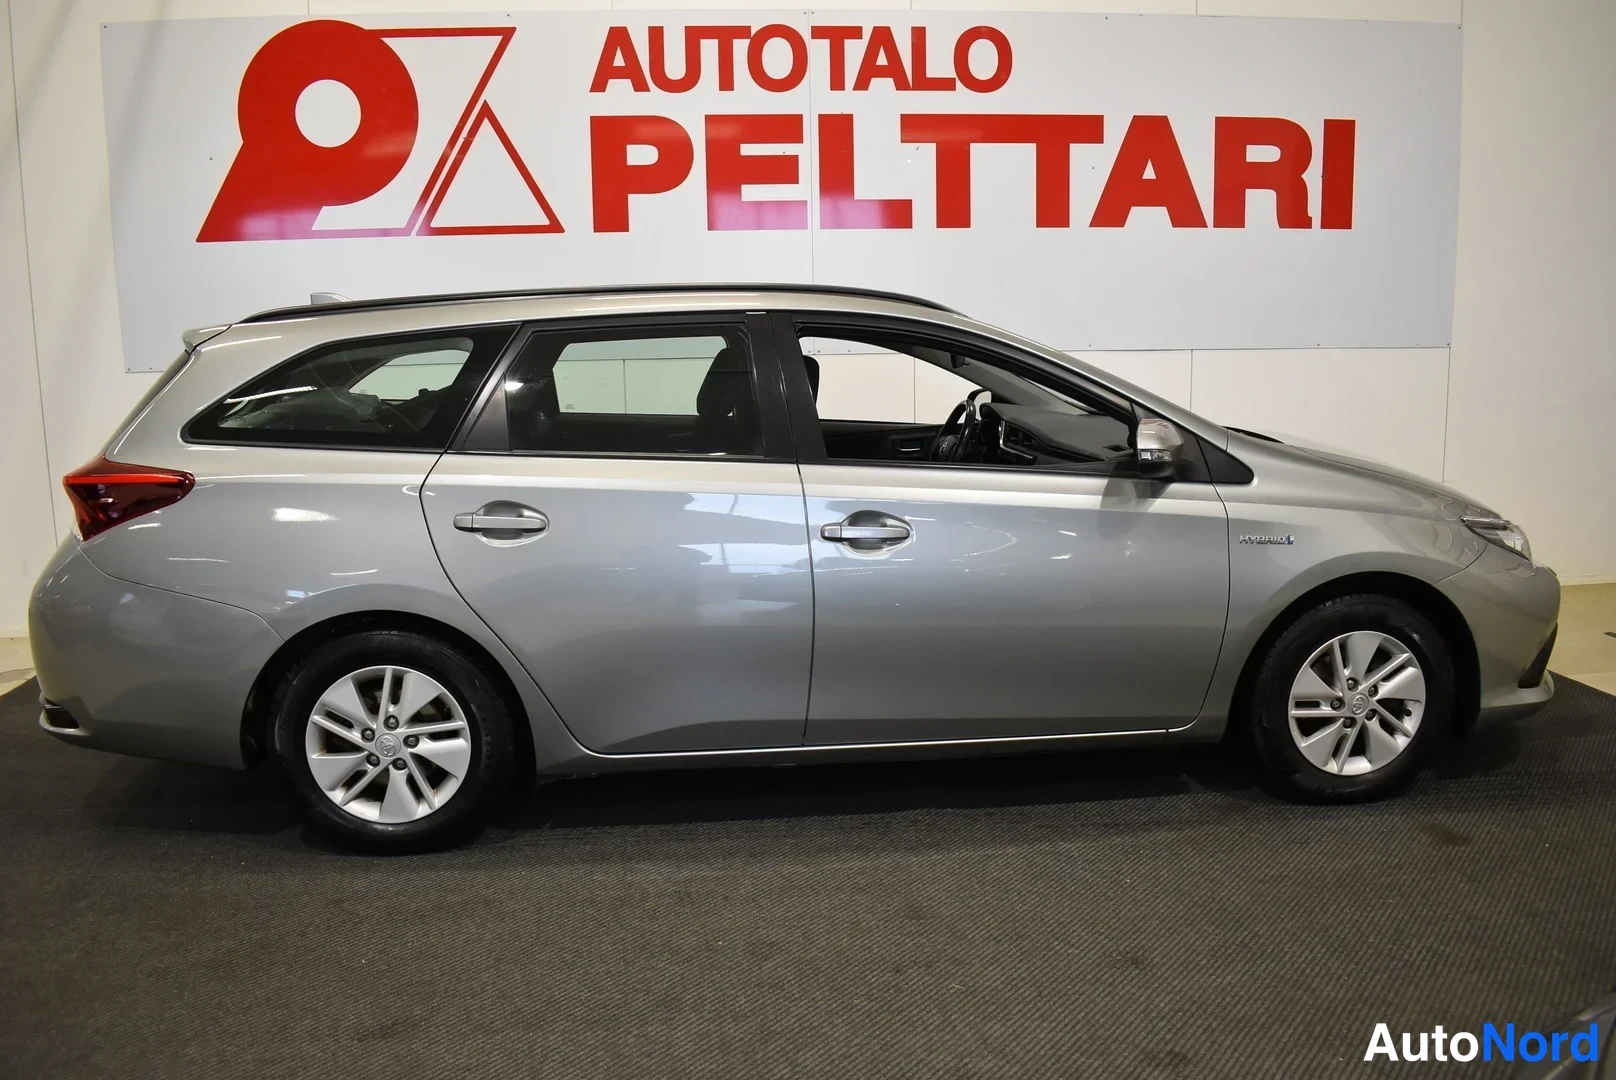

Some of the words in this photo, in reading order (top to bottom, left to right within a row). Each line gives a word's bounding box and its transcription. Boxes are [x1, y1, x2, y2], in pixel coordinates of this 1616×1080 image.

[590, 24, 1013, 93] AUTOTALO
[590, 113, 1357, 233] PELTTARI
[1239, 534, 1286, 545] HYBRID
